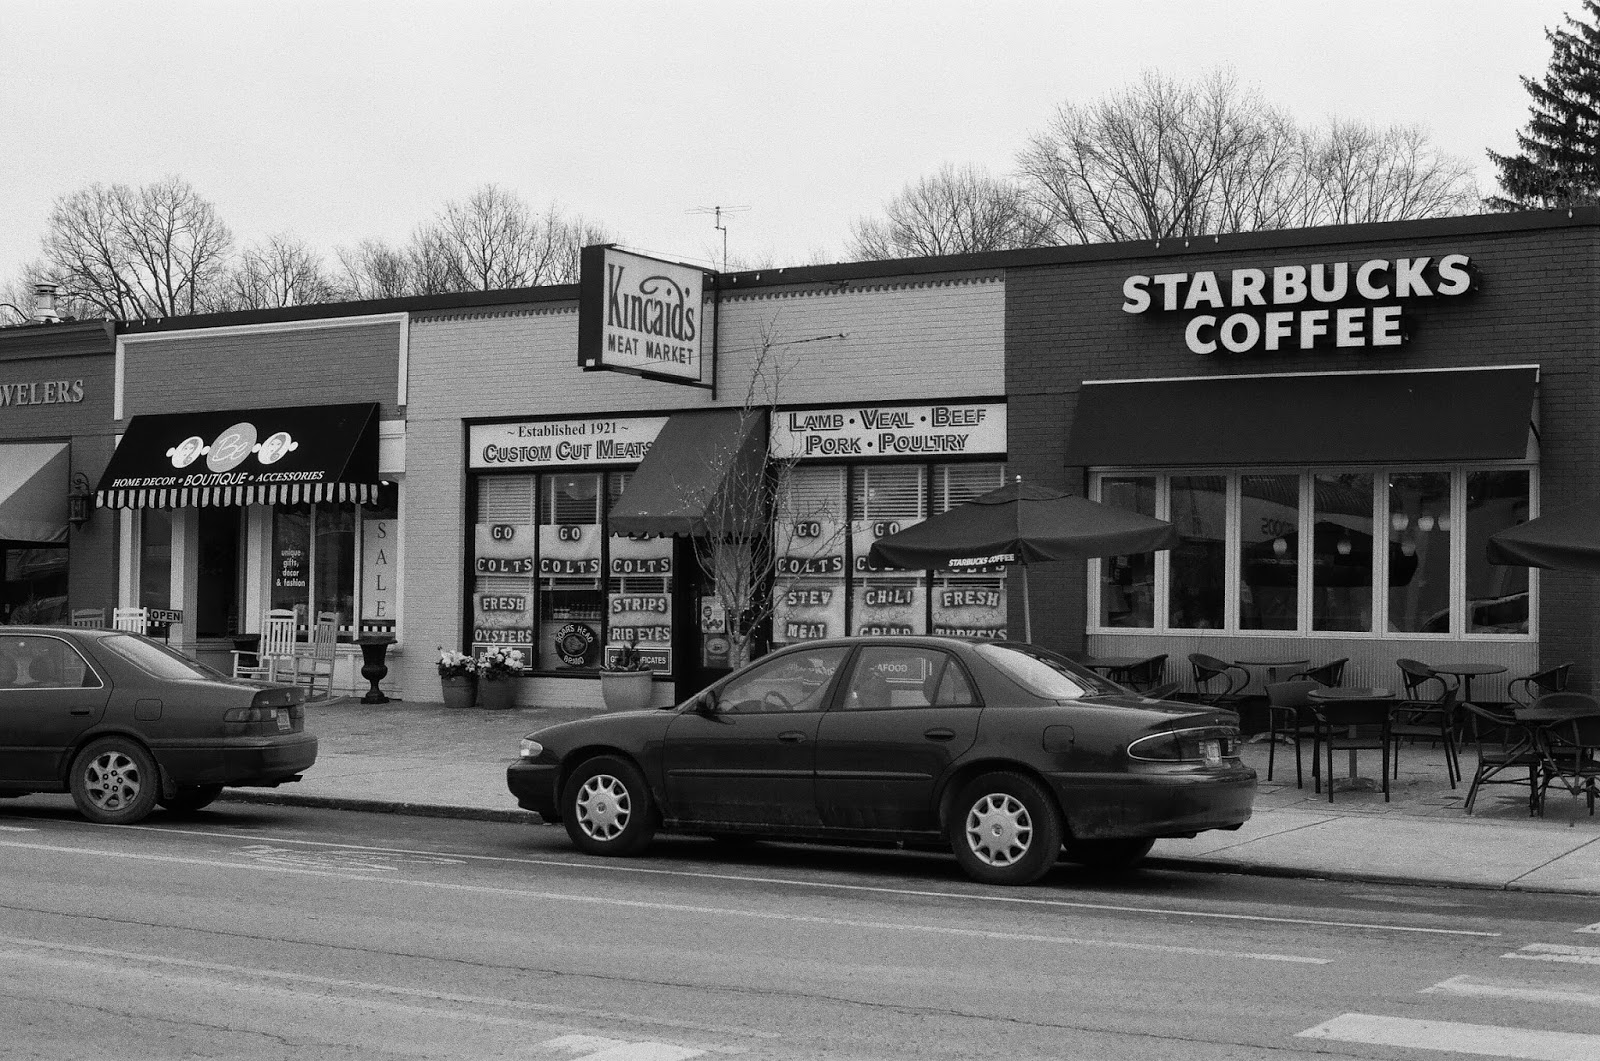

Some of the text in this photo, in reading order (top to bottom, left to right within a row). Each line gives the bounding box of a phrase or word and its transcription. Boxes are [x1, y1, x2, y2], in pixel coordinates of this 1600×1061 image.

[1122, 254, 1471, 314] STARBUCKS
[608, 264, 695, 342] Kincaid's
[1185, 306, 1403, 354] COFFEE
[608, 333, 693, 365] MEAT MARKET
[0, 380, 84, 406] WELERS
[790, 407, 987, 431] LAMB VEAL BEEF
[518, 422, 617, 438] Established 1921
[806, 433, 969, 455] PORK POULTRY
[483, 444, 551, 463] CUSTOM
[556, 441, 592, 460] CUT
[112, 471, 325, 487] HOME DECOR BOUTIQUE ACCESSORIES
[493, 527, 514, 540] GO
[560, 527, 581, 540] GO
[797, 523, 820, 537] GO
[874, 522, 900, 537] GO
[281, 547, 302, 559] unique
[948, 553, 1015, 567] STARBUCKS COFFEE
[282, 568, 300, 577] decor
[375, 522, 388, 617] SALE
[477, 558, 533, 573] COLTS
[540, 558, 599, 573] COLTS
[612, 558, 669, 573] COLTS
[777, 557, 843, 573] COLTS
[284, 578, 306, 587] fashion
[483, 597, 525, 611] FRESH
[613, 597, 665, 613] STRIPS
[788, 590, 831, 605] STEW
[866, 590, 912, 605] CHILI
[943, 591, 999, 608] FRESH
[152, 610, 180, 621] OPEN
[475, 628, 532, 643] OYSTERS
[577, 625, 594, 643] HEAD
[612, 627, 670, 640] RIB EYES
[787, 624, 825, 639] MEAT
